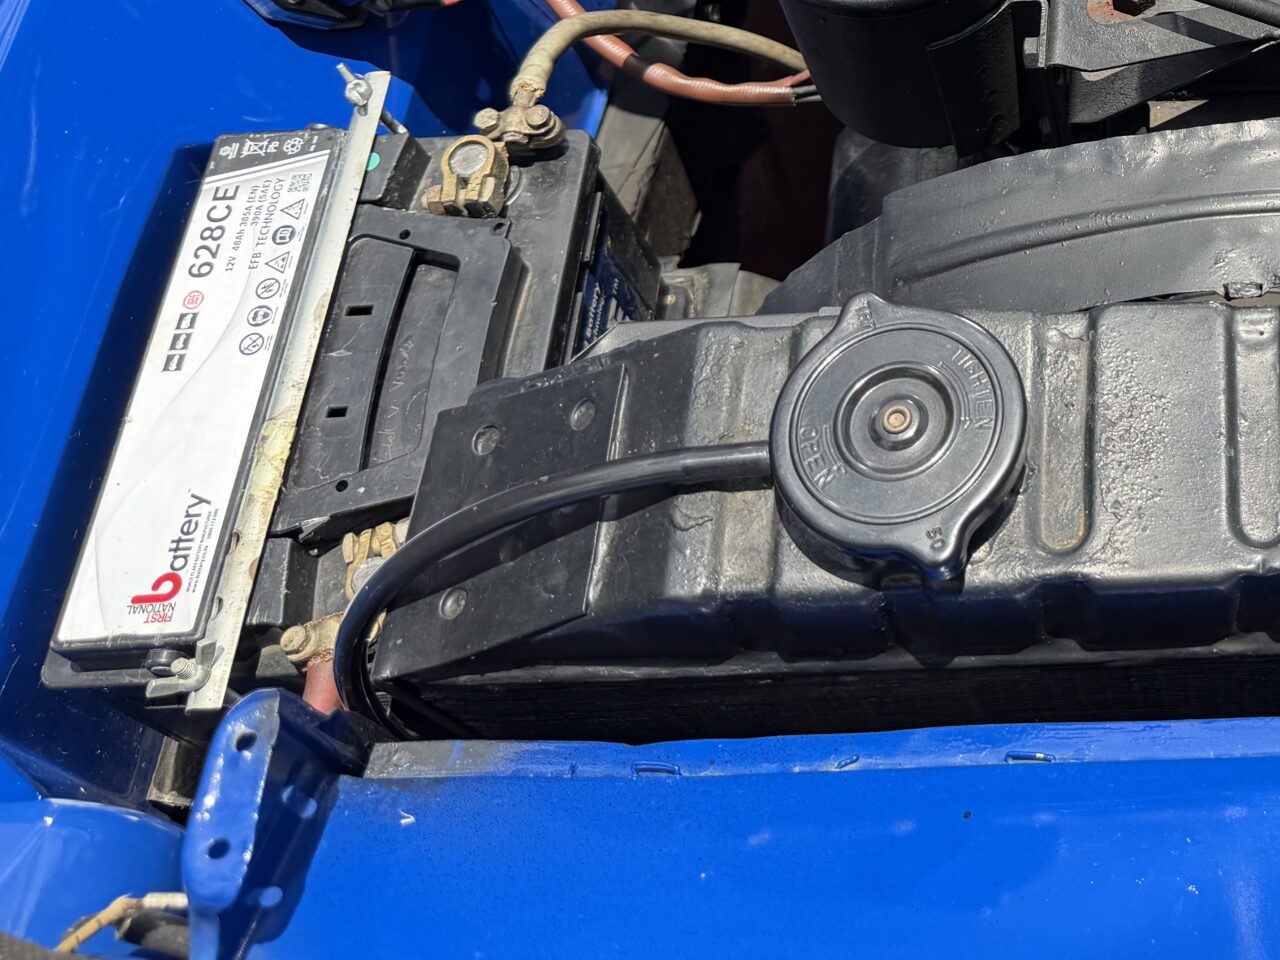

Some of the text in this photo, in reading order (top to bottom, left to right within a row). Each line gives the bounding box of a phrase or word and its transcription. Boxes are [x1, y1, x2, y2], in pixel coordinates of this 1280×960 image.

[188, 185, 240, 278] 628CE
[225, 185, 261, 272] 12V 48Ah 385A (EN)
[248, 178, 285, 270] EFB TECHNOLOGY
[251, 179, 273, 227] 390A (SAE)
[585, 282, 601, 338] Battery
[952, 350, 993, 431] TIGHTEN
[800, 427, 834, 488] OPEN
[131, 493, 212, 604] battery
[926, 526, 946, 550] 50
[126, 601, 177, 615] NATIONAL
[143, 612, 174, 624] FIRST
